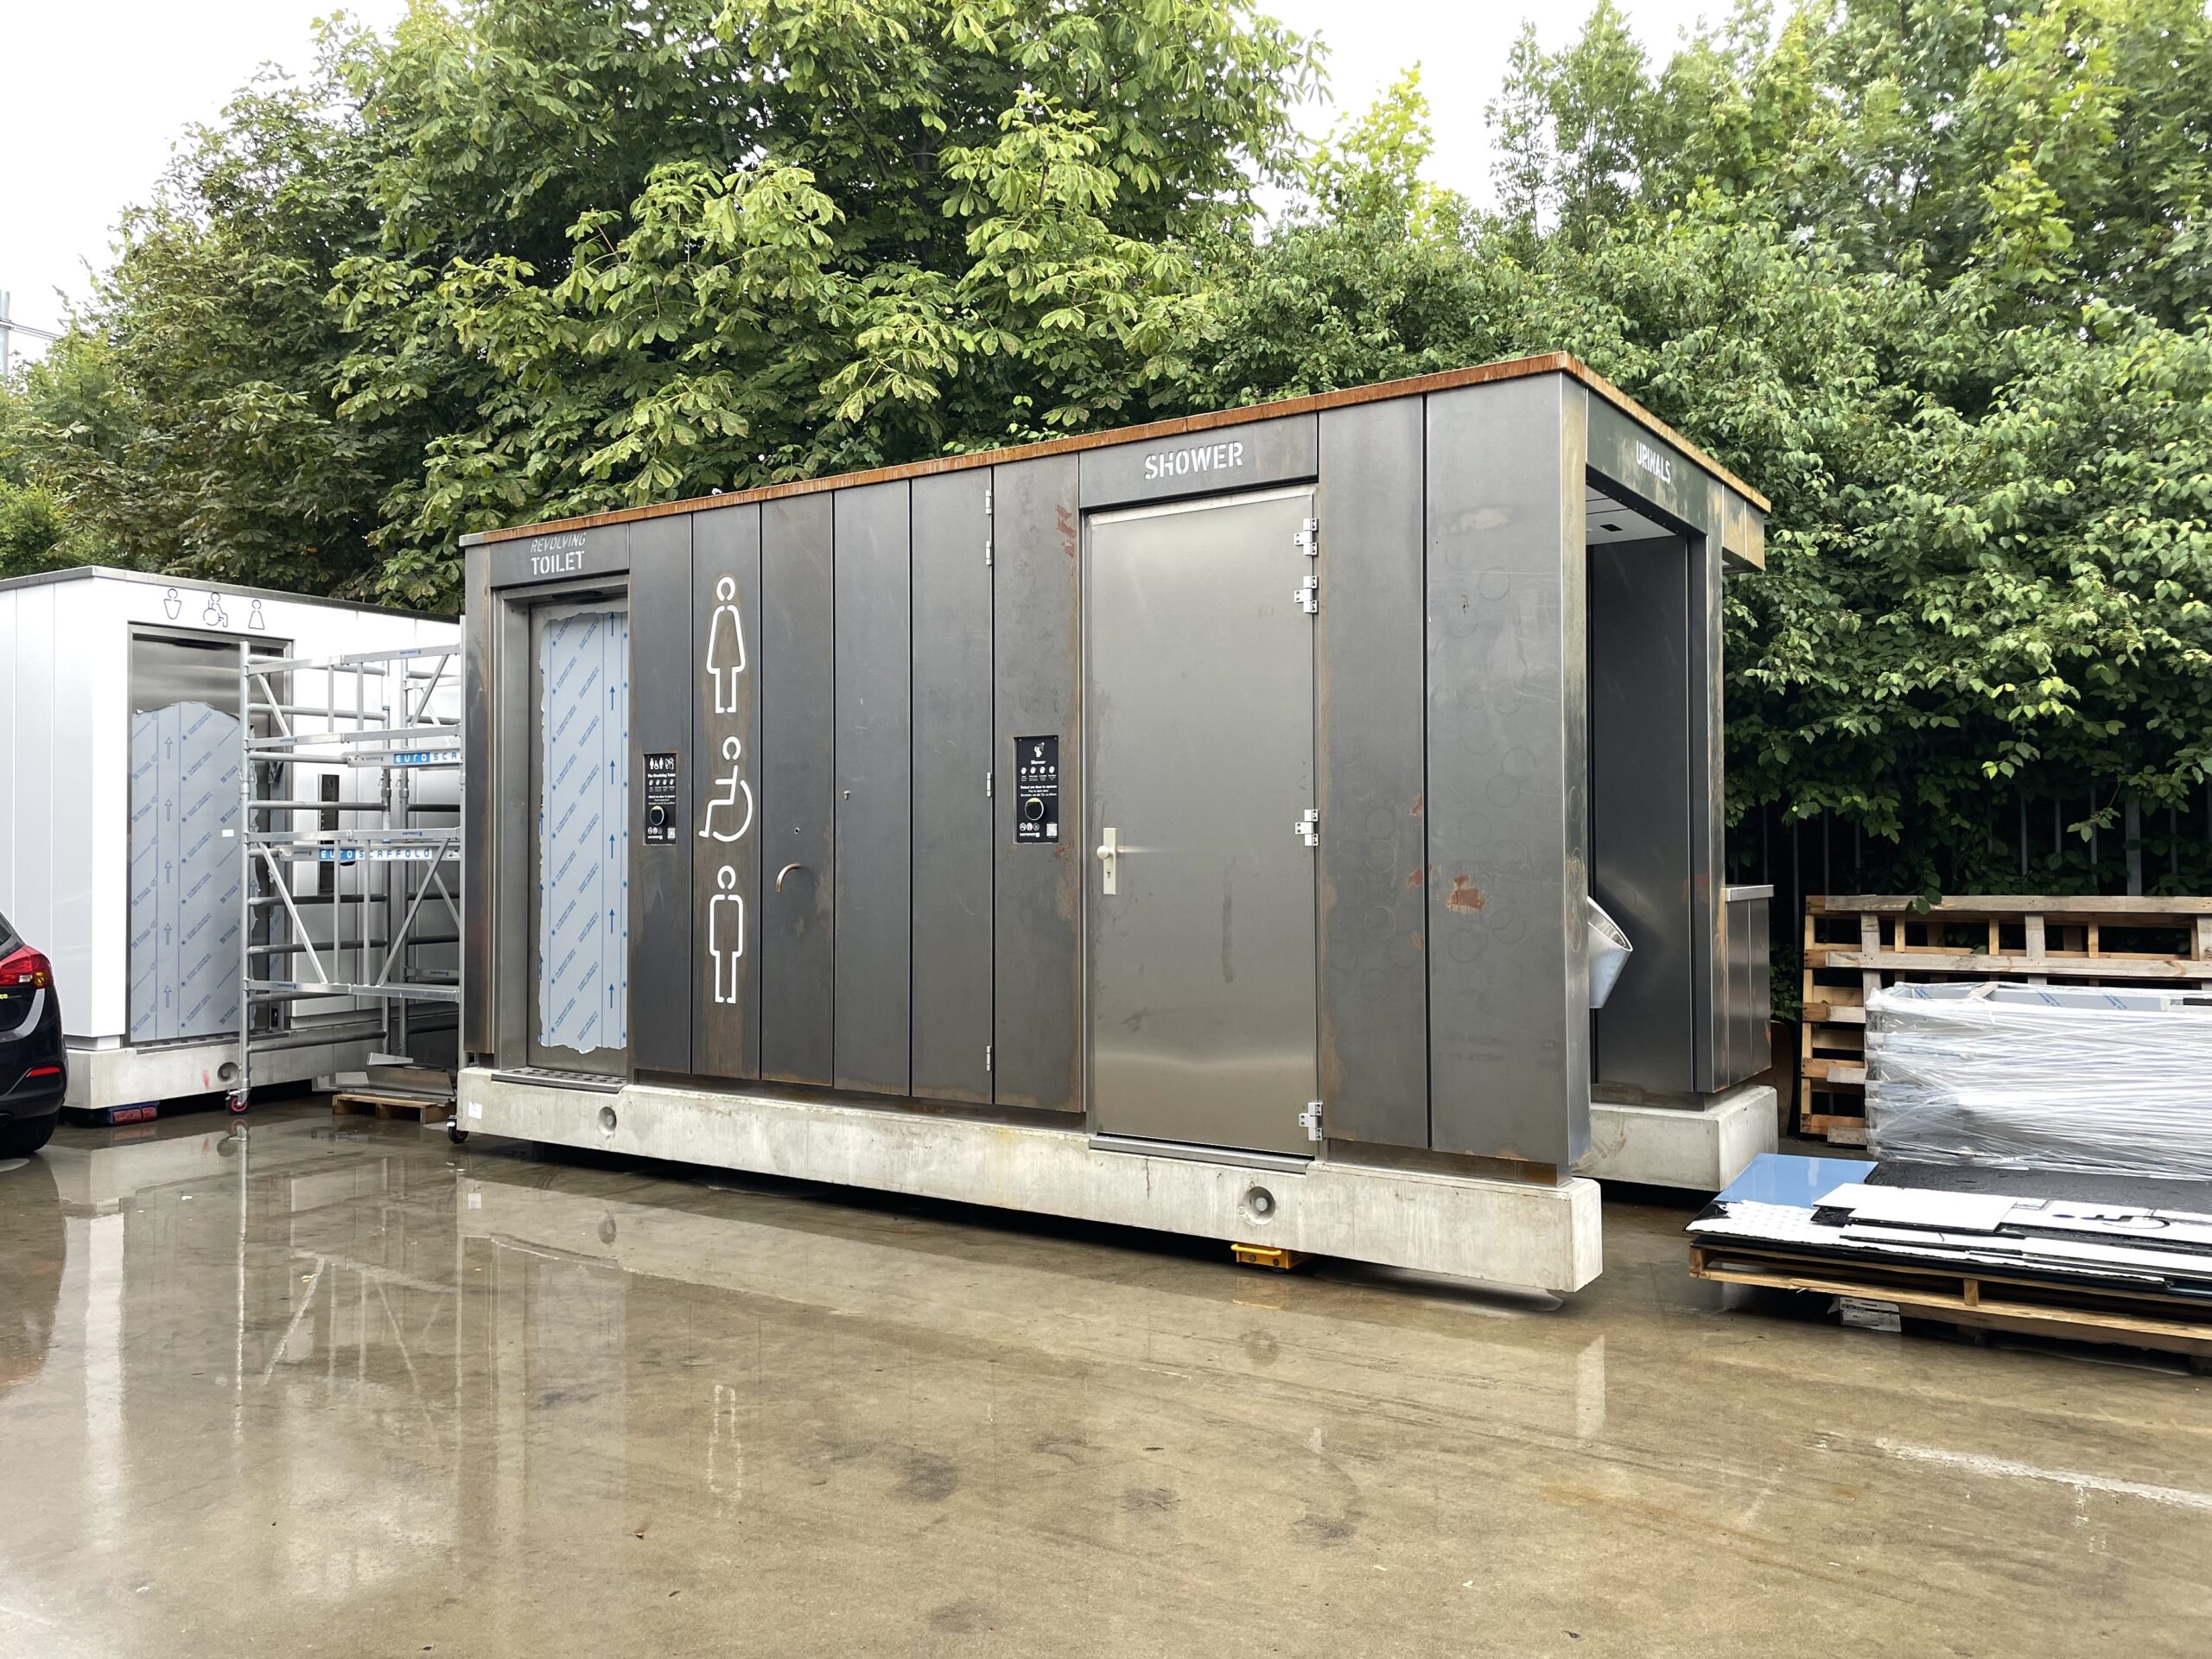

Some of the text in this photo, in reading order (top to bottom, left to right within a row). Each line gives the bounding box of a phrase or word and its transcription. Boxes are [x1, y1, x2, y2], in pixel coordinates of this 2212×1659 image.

[1145, 442, 1243, 480] SHOWER
[1636, 440, 1671, 485] URINALS
[531, 531, 587, 554] REVOLVING
[531, 550, 585, 575] TOILET
